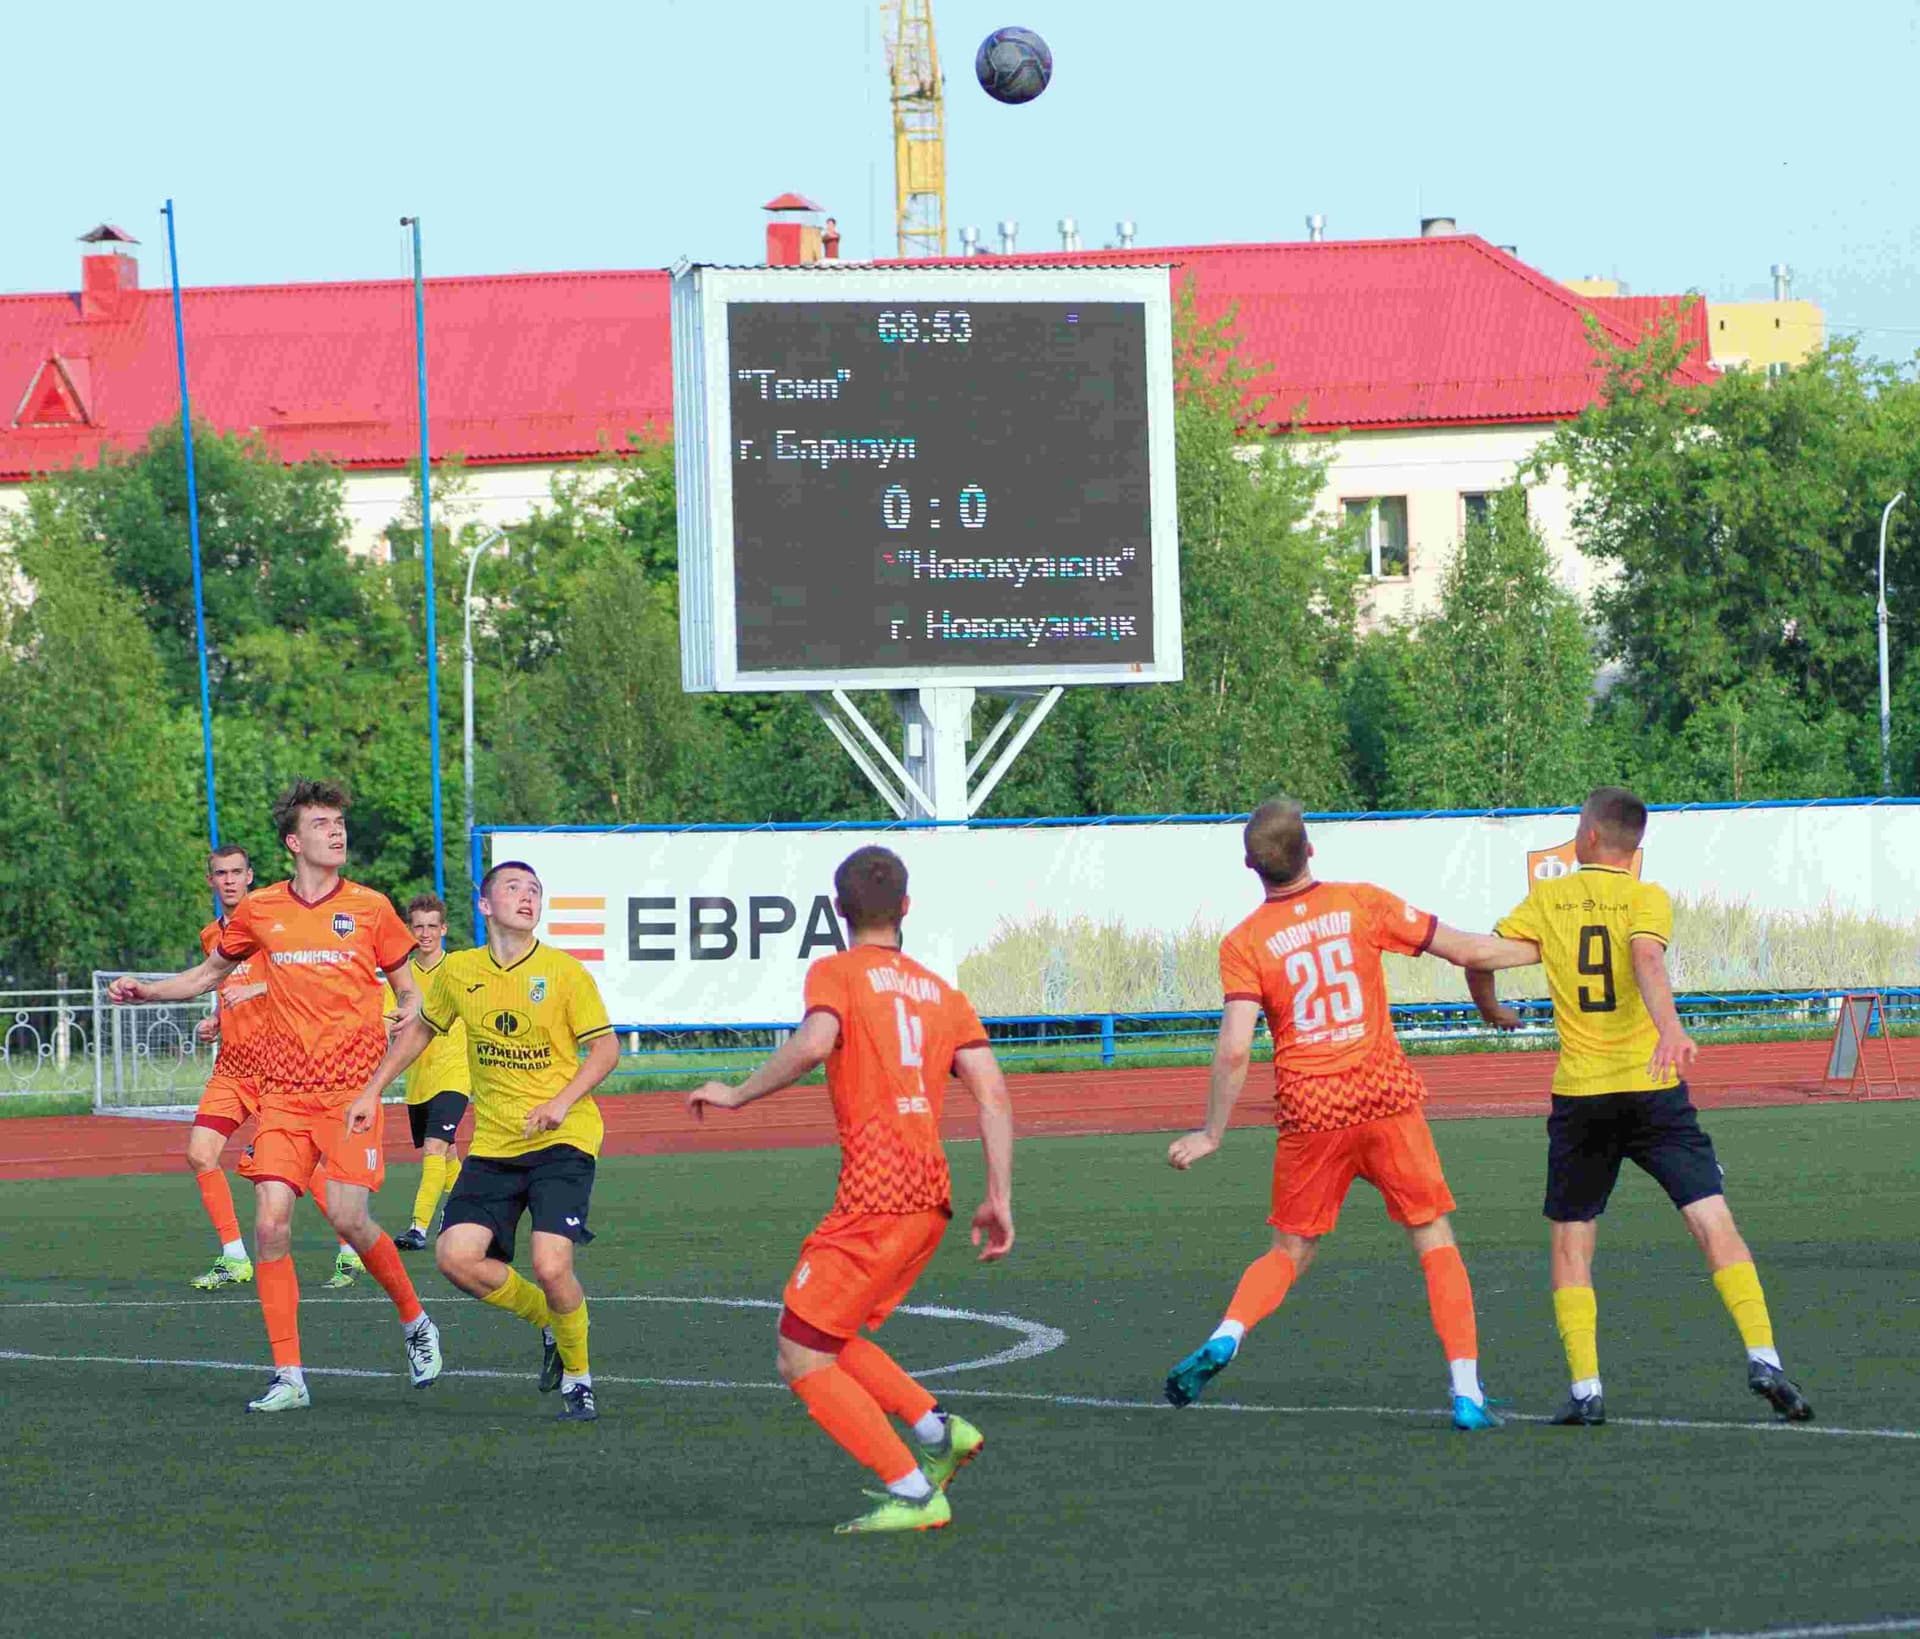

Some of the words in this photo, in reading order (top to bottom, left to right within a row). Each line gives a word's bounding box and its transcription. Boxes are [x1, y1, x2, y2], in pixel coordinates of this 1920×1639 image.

[878, 310, 973, 343] 68:53
[739, 439, 762, 460] г.
[882, 484, 911, 529] 0
[959, 483, 988, 529] 0
[891, 619, 912, 640] г.
[1285, 938, 1364, 1032] 25
[1577, 925, 1617, 1013] 9
[894, 997, 924, 1067] 4
